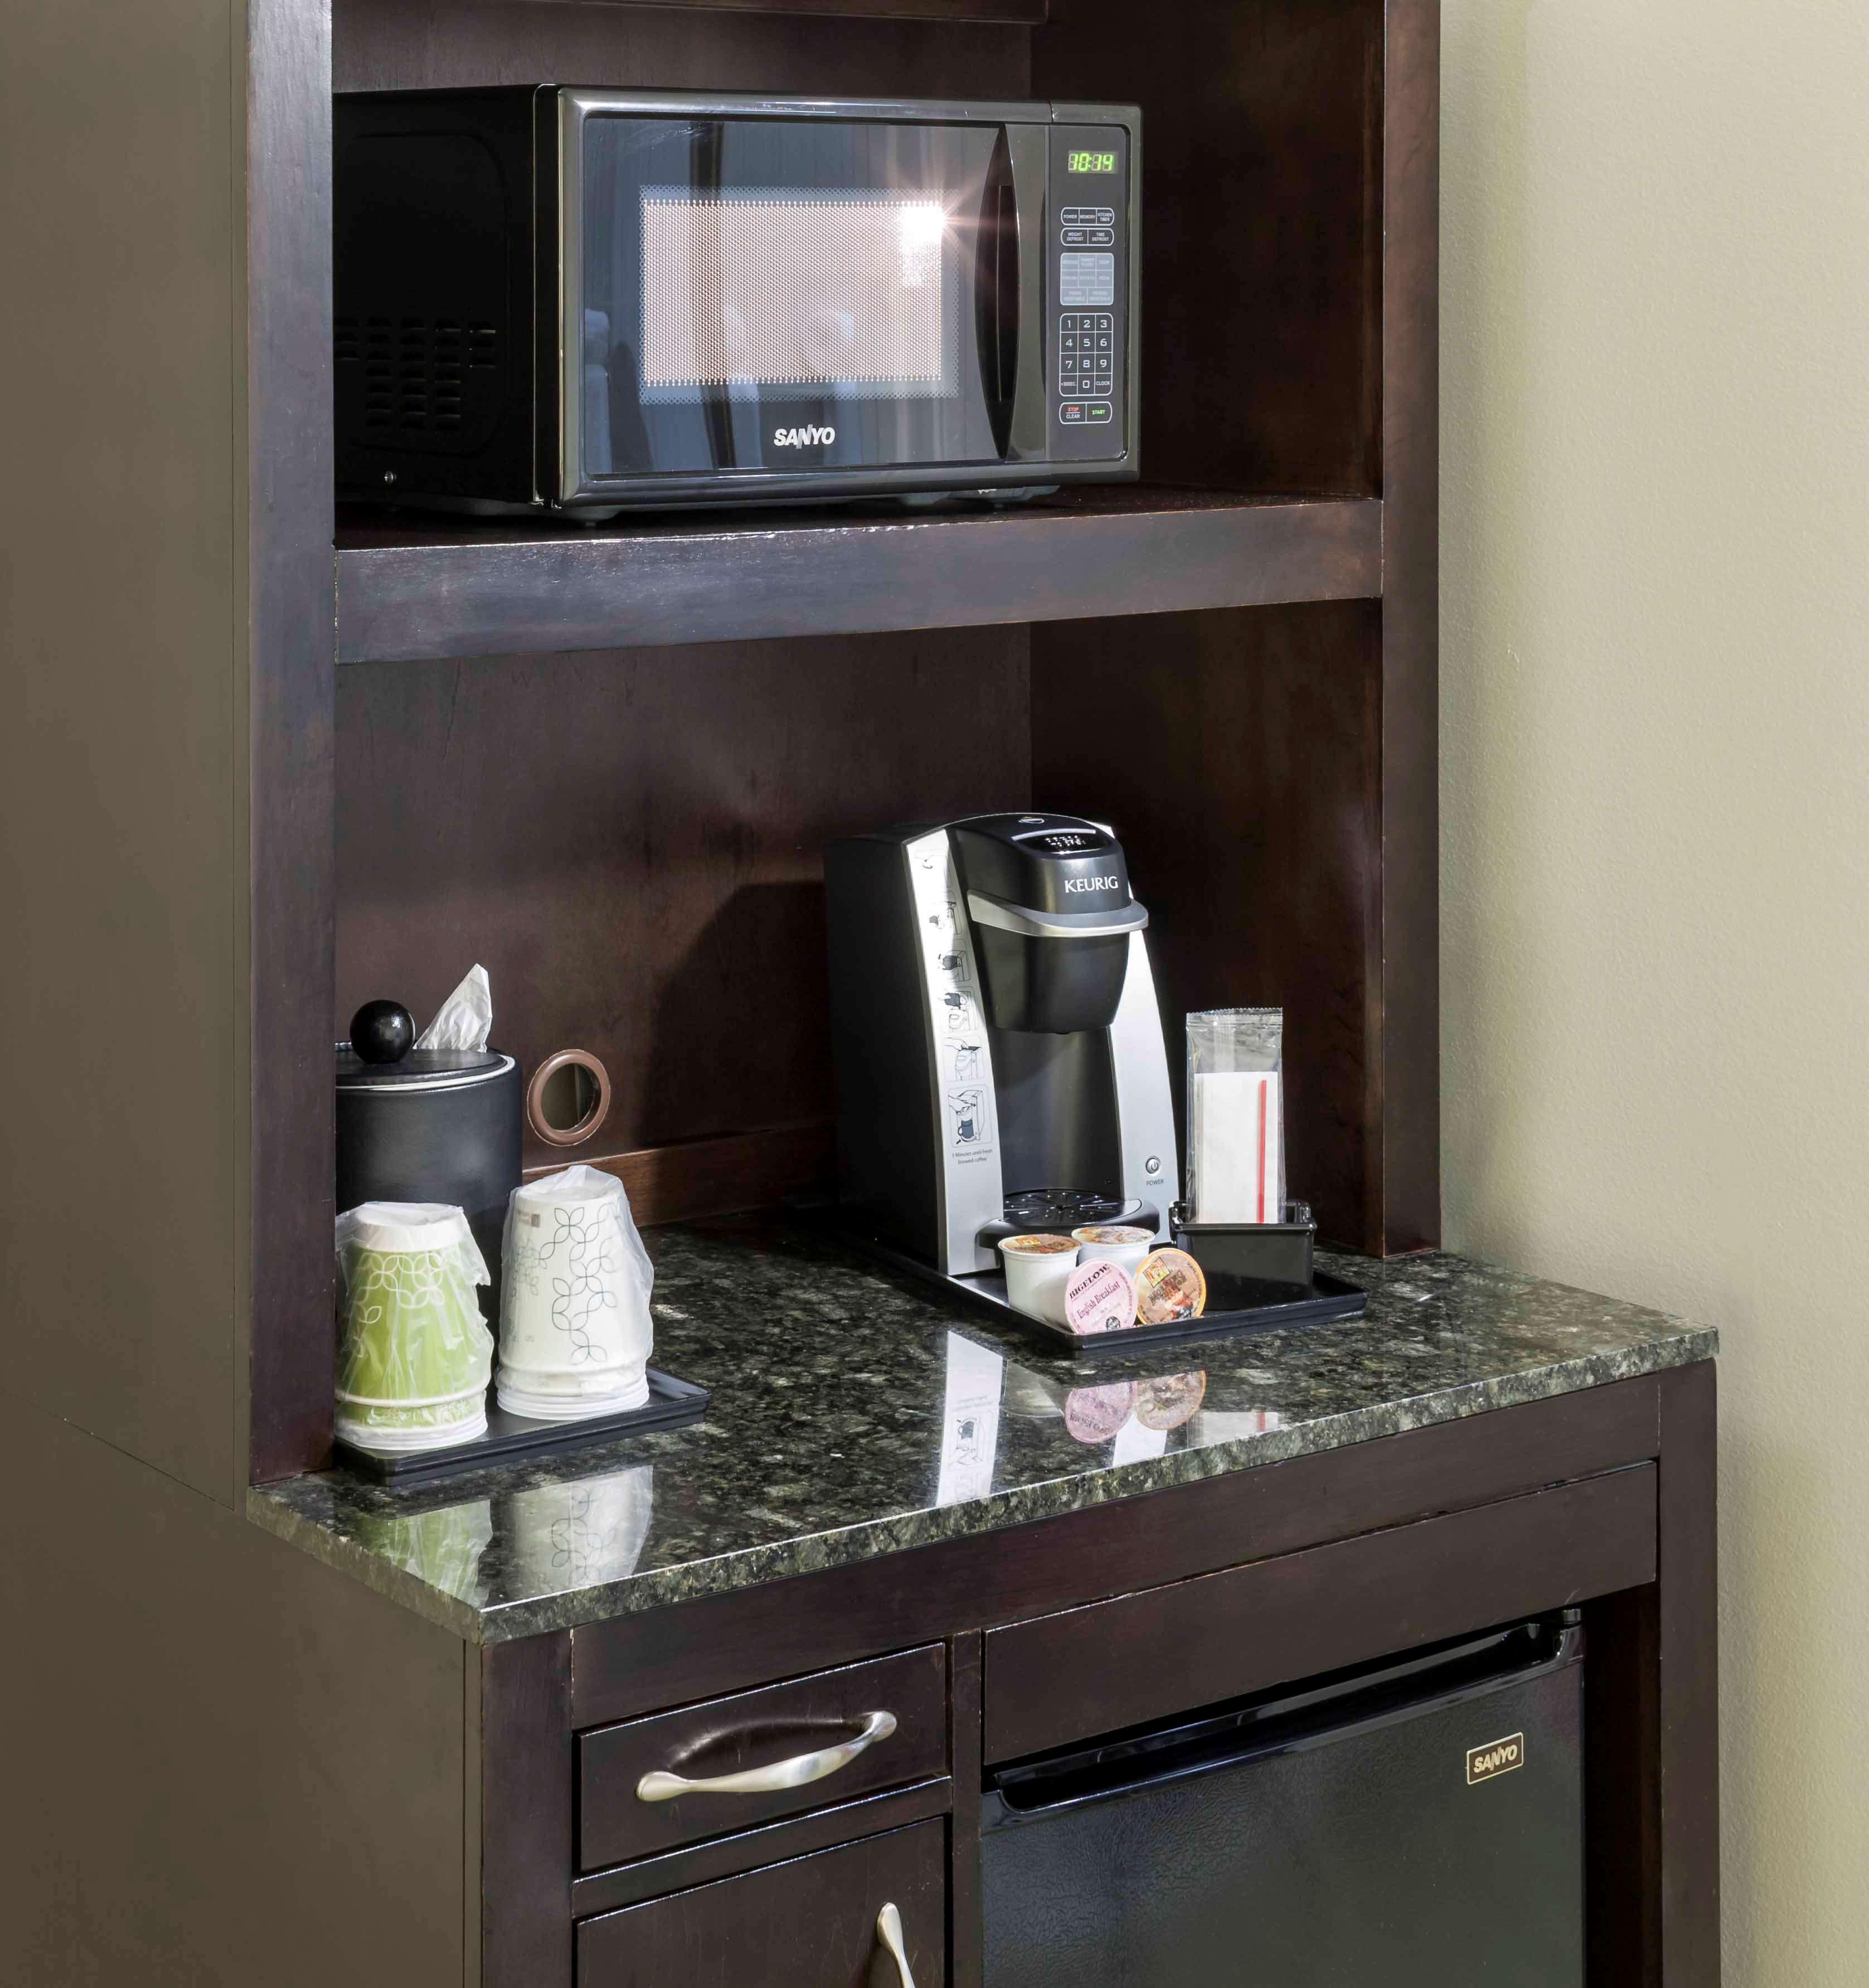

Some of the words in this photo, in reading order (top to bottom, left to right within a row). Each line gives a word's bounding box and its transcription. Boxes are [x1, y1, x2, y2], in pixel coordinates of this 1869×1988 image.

[1071, 153, 1113, 172] 10:14
[1067, 320, 1071, 328] 1
[1100, 319, 1107, 328] 3
[1065, 338, 1073, 347] 4
[1083, 338, 1090, 347] 5
[1100, 338, 1107, 346] 6
[1065, 360, 1072, 368] 7
[1083, 360, 1090, 368] 8
[1100, 359, 1107, 367] 9
[774, 424, 836, 449] SANYO
[1064, 876, 1119, 893] KEURIG
[1070, 1263, 1109, 1300] BIGELOW
[1077, 1299, 1096, 1319] English
[1094, 1281, 1120, 1304] Breakfast
[1473, 1744, 1518, 1773] SANYO
